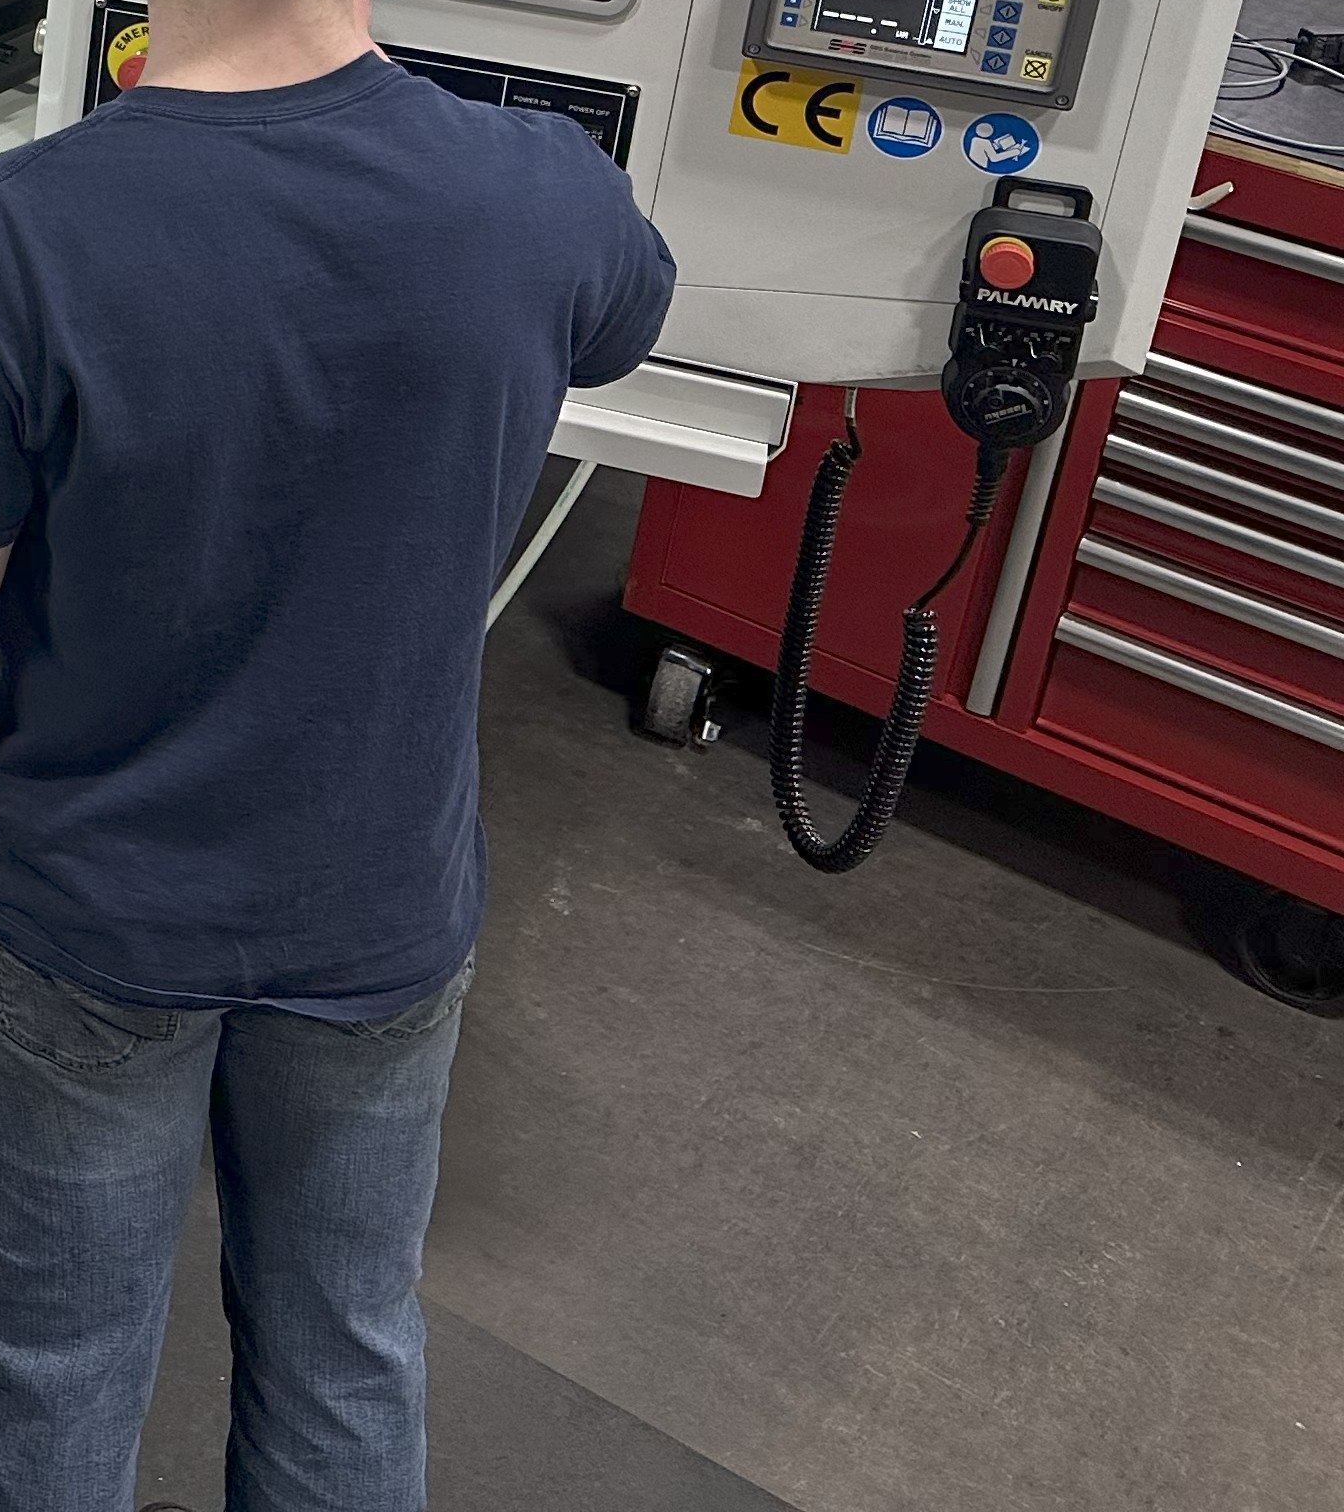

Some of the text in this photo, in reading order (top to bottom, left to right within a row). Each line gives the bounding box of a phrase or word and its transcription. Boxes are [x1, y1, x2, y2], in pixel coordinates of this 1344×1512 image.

[948, 5, 966, 14] ALL
[938, 36, 963, 46] AUTO
[1024, 49, 1053, 58] CANCEL
[513, 95, 539, 105] POWER
[568, 104, 611, 117] POWER OFF
[741, 71, 856, 147] CE
[977, 288, 1078, 315] PALMARY
